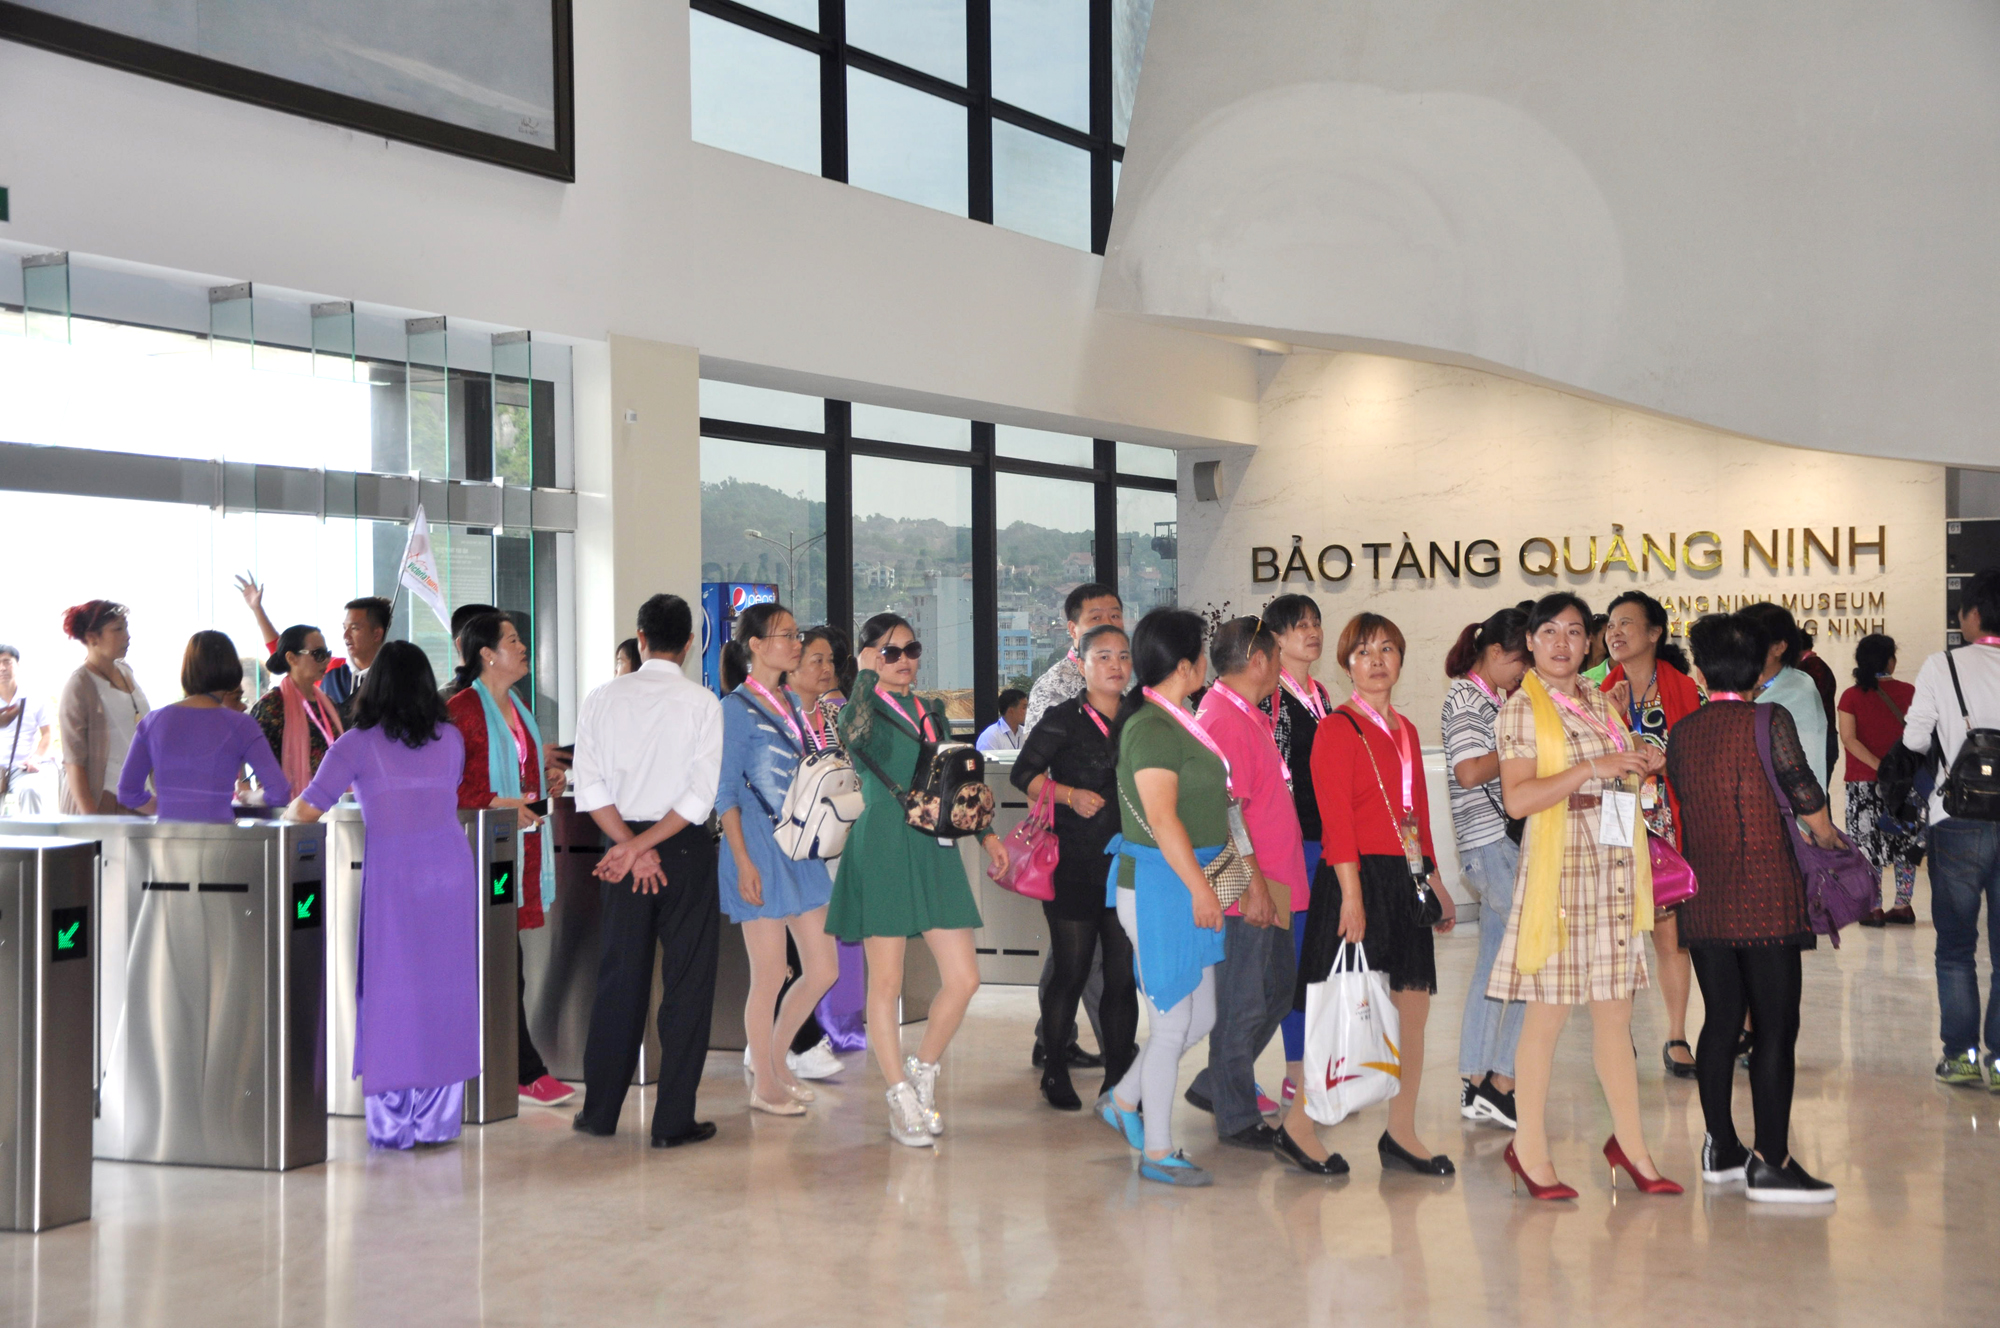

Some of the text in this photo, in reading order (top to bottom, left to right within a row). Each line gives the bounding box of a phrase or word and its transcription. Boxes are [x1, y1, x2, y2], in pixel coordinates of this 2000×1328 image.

[1251, 523, 1886, 583] BẢO TÀNG QUẢNG NINH
[747, 592, 776, 607] pepsi
[1657, 595, 1710, 613] ANG
[1781, 591, 1885, 612] MUSEUM
[1828, 618, 1885, 637] NINH
